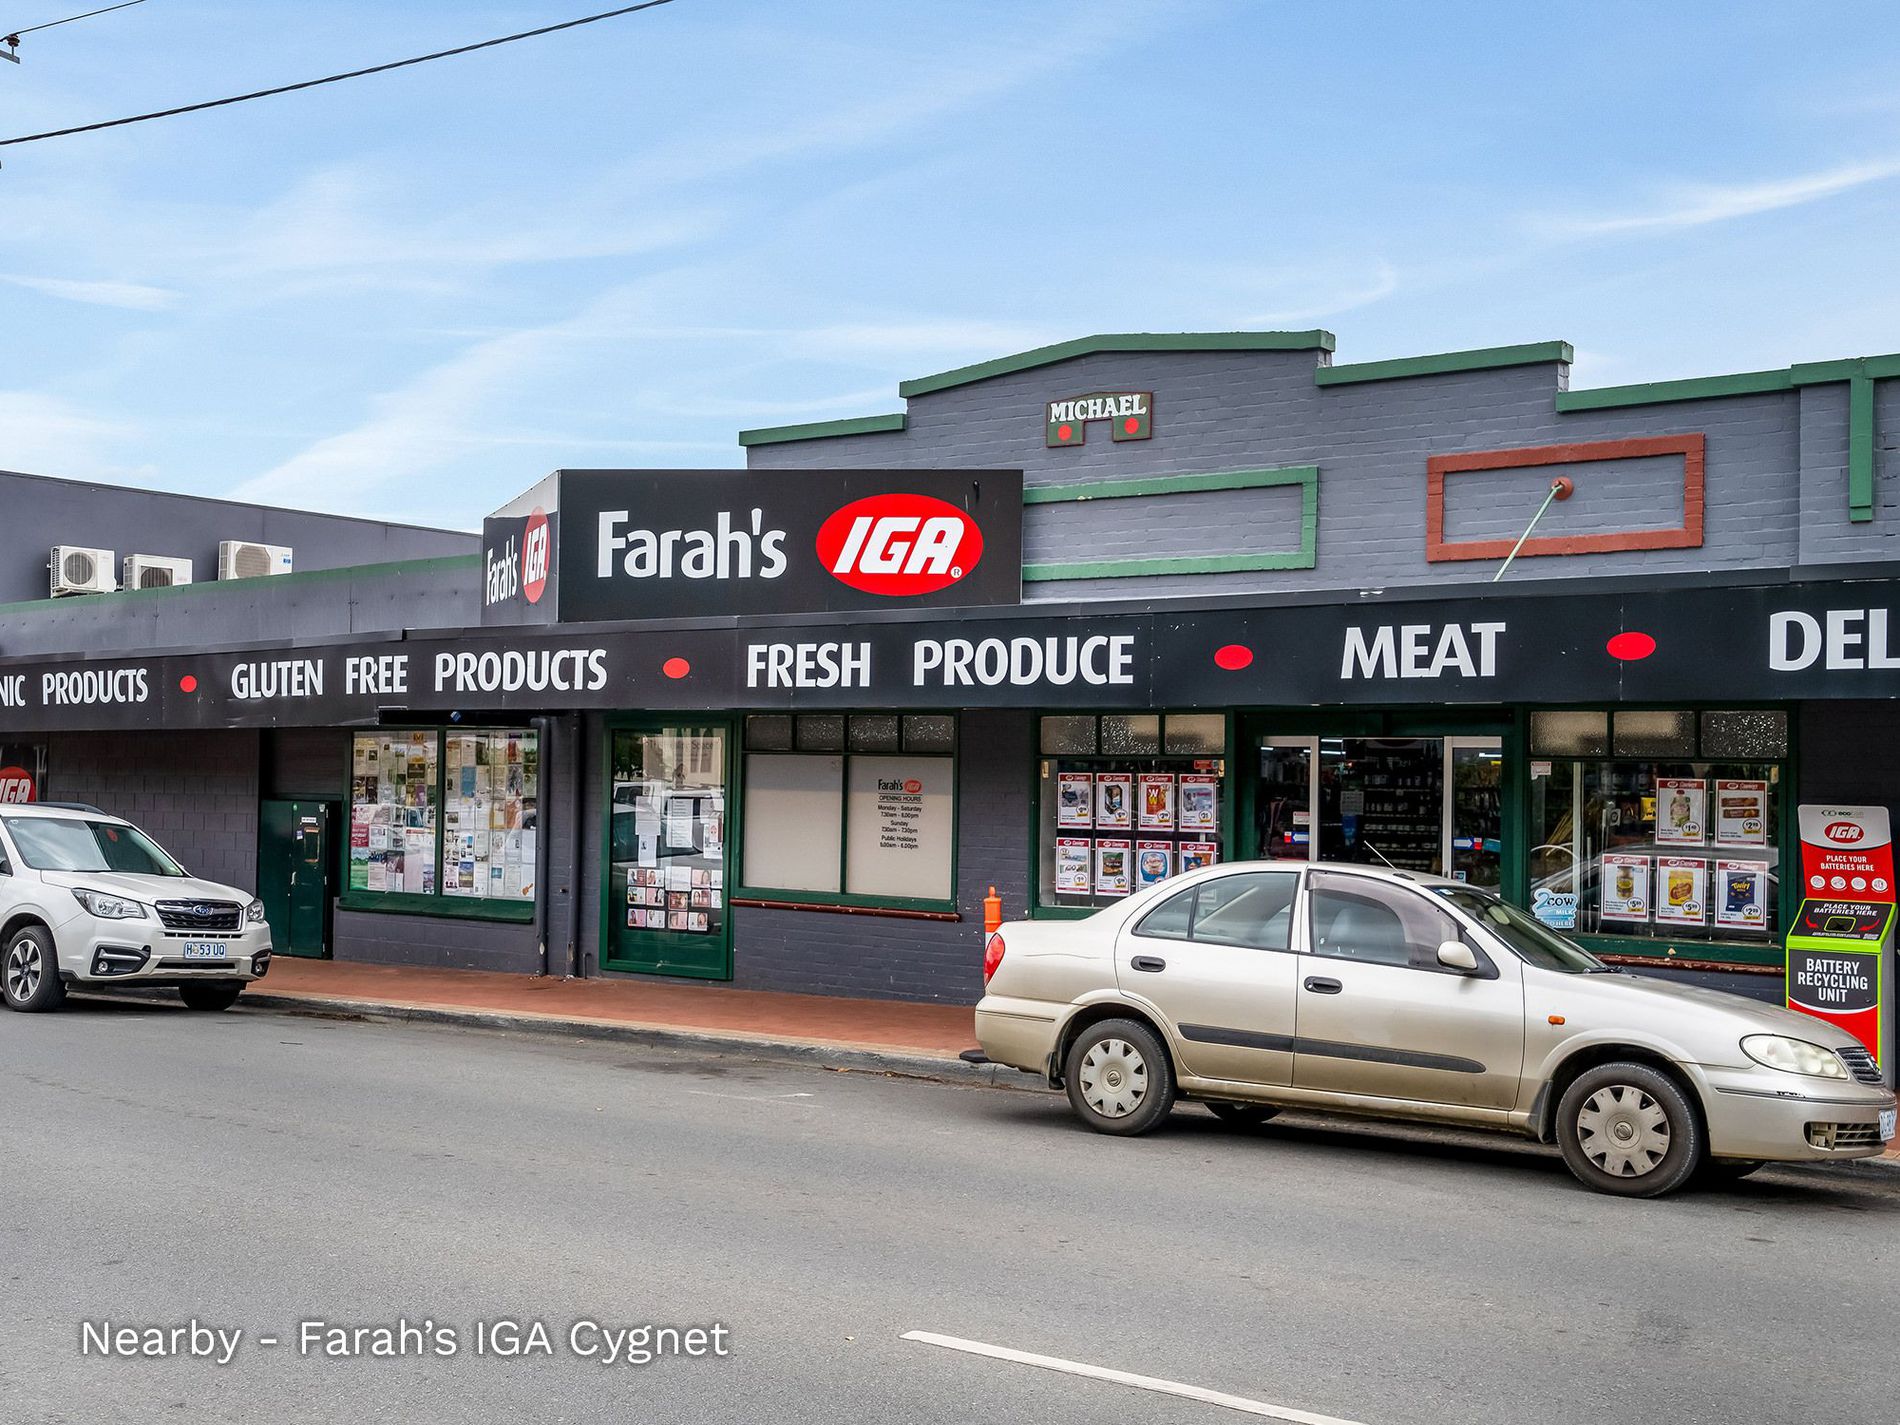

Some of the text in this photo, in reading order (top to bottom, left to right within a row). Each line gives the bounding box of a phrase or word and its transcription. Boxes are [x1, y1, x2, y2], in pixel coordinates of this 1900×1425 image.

[1050, 395, 1147, 423] MICHAEL
[597, 507, 965, 579] Farah's IGA
[486, 523, 548, 607] Farah's IGA
[1340, 622, 1506, 679] MEAT
[1769, 608, 1900, 671] DEL
[231, 648, 608, 699] GLUTEN FREE PRODUCTS
[747, 634, 1135, 688] FRESH PRODUCE
[42, 668, 149, 705] PRODUCTS
[878, 779, 903, 790] Farah's
[1829, 826, 1859, 839] IGA
[1820, 862, 1874, 872] BATTERIES HERE
[1826, 855, 1867, 863] PLACE YOUR
[1797, 971, 1869, 990] RECYCLING
[1806, 958, 1860, 975] BATTERY
[1818, 987, 1848, 1003] UNIT
